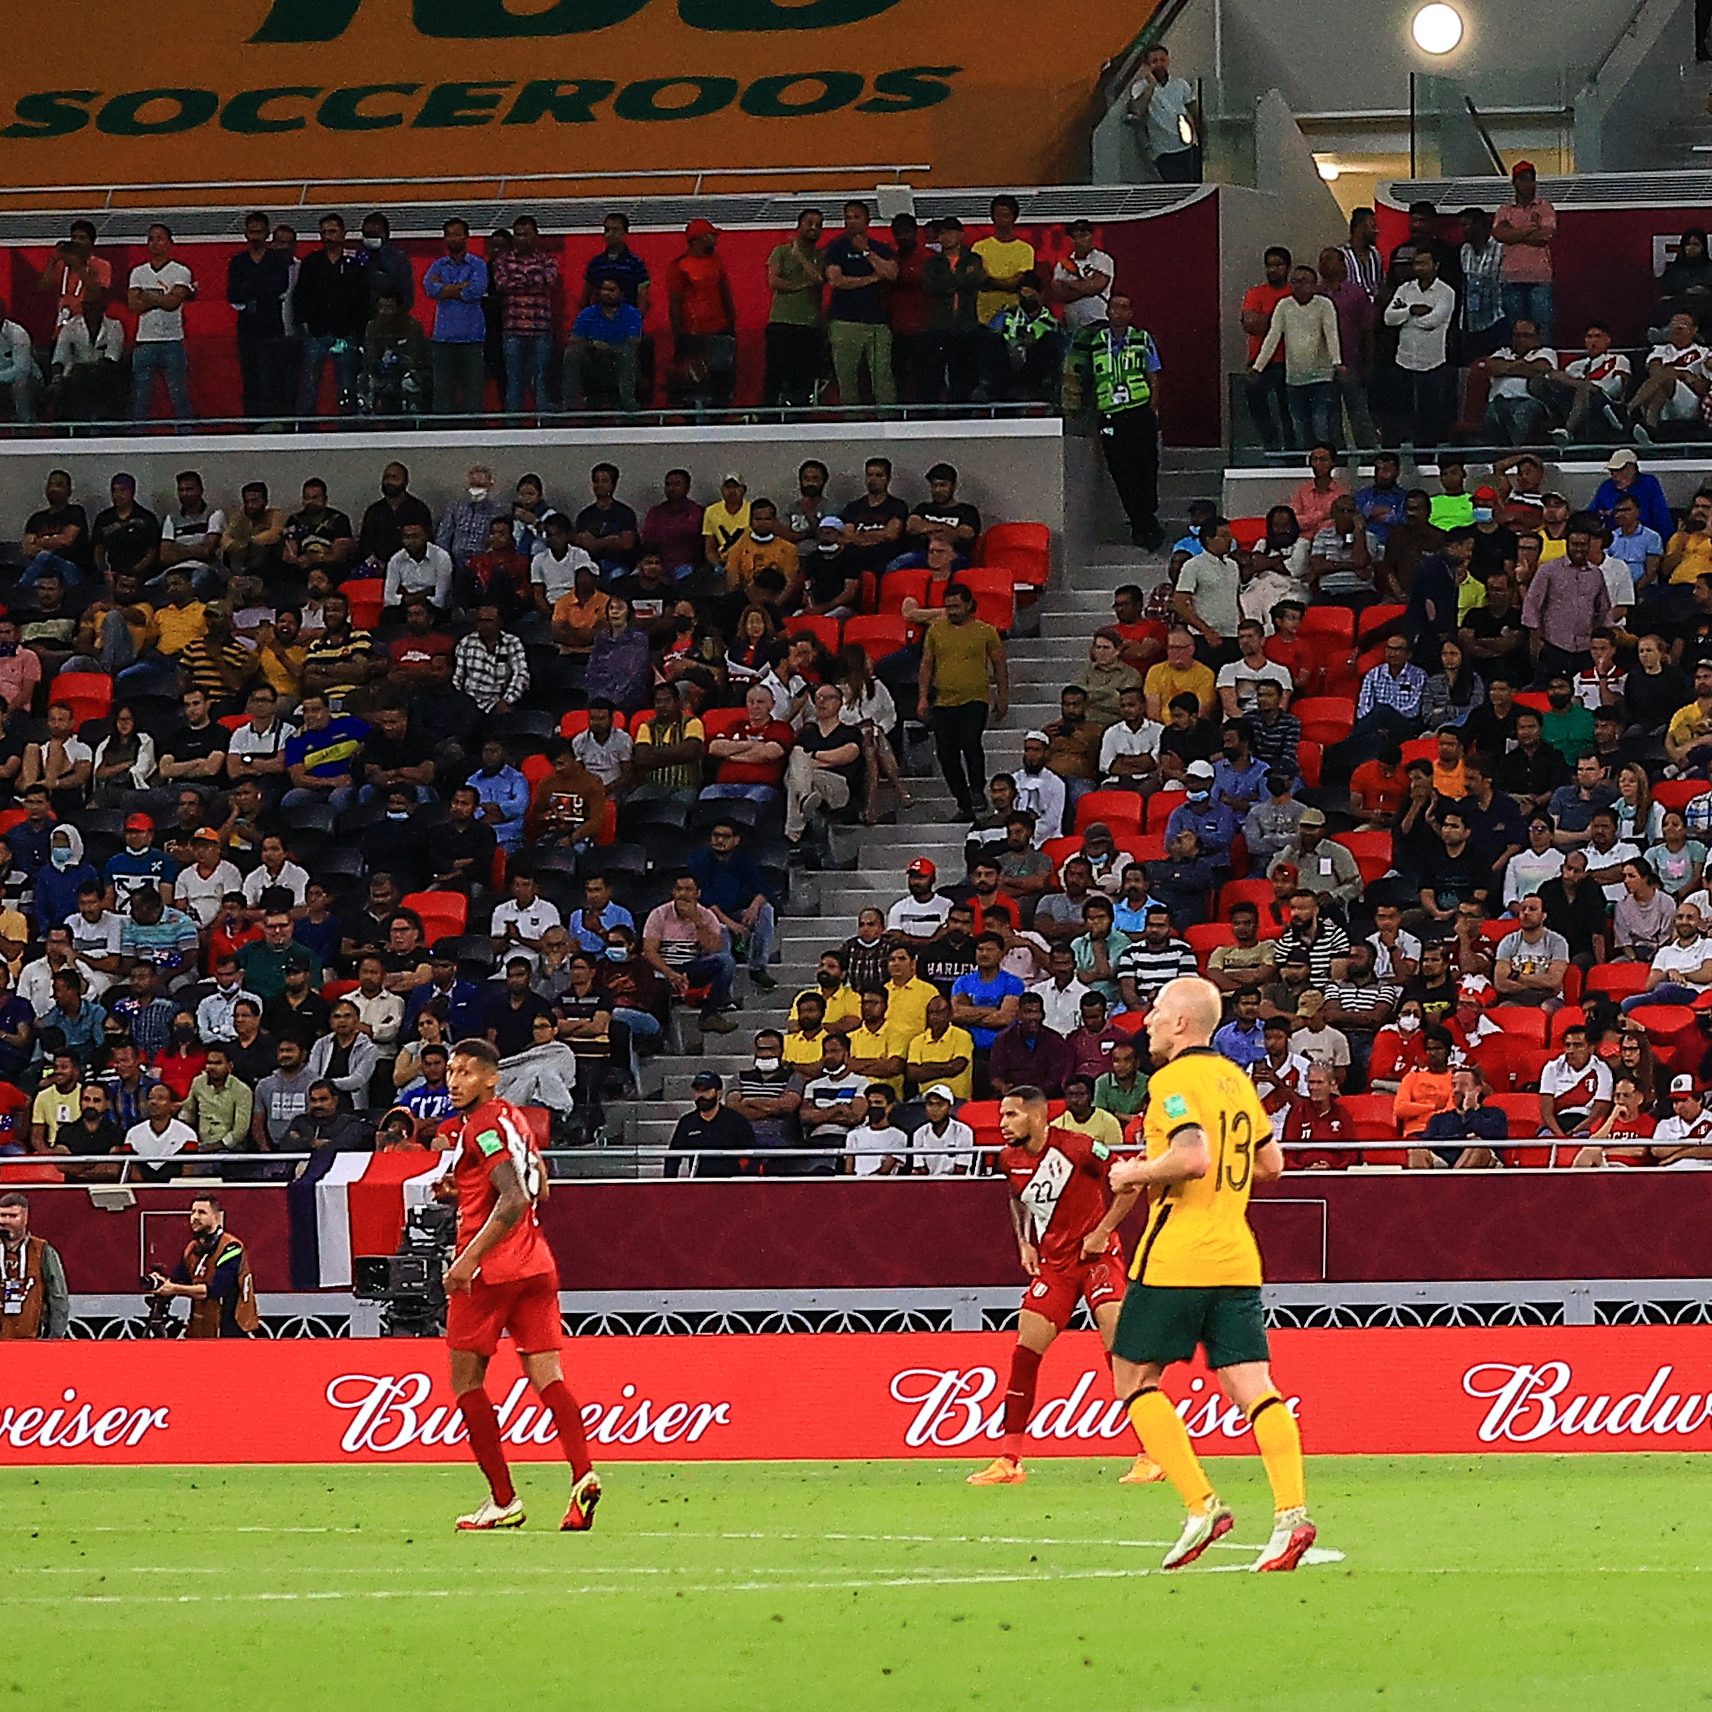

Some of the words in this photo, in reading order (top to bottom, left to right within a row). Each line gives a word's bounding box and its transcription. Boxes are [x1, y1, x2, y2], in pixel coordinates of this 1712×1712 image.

[2, 67, 963, 140] SOCCEROOS
[927, 962, 980, 976] HARLEM
[1214, 1110, 1252, 1192] 13
[1029, 1180, 1054, 1204] 22
